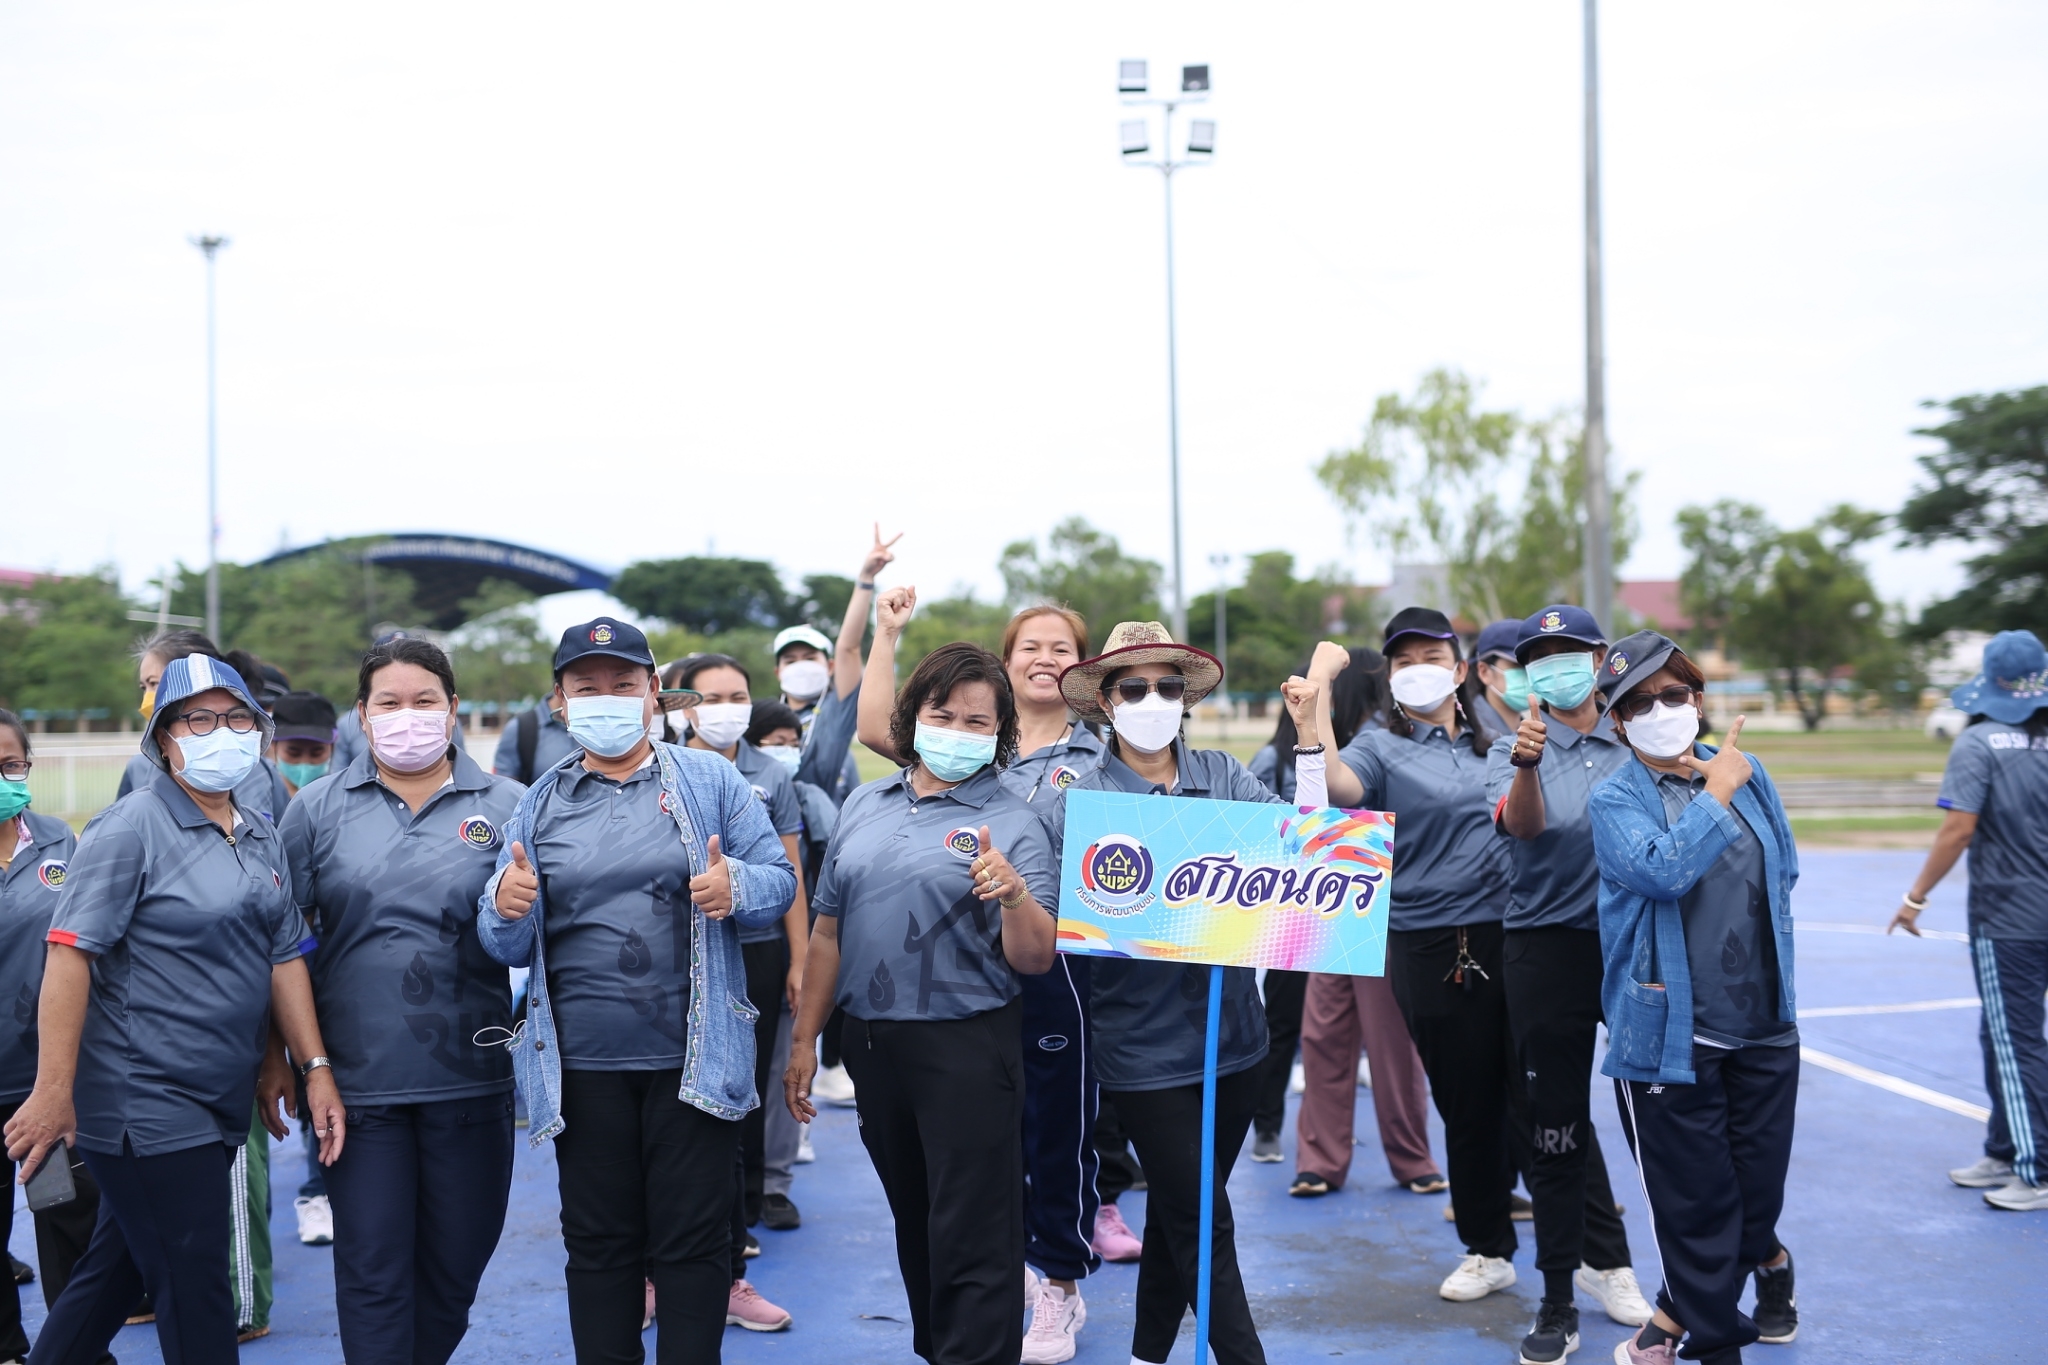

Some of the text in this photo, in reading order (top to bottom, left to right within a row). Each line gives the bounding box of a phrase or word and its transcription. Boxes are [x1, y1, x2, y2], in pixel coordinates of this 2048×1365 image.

[1075, 886, 1156, 916] กรมการพัฒนาชุมชน
[1164, 854, 1383, 913] สกลนคร
